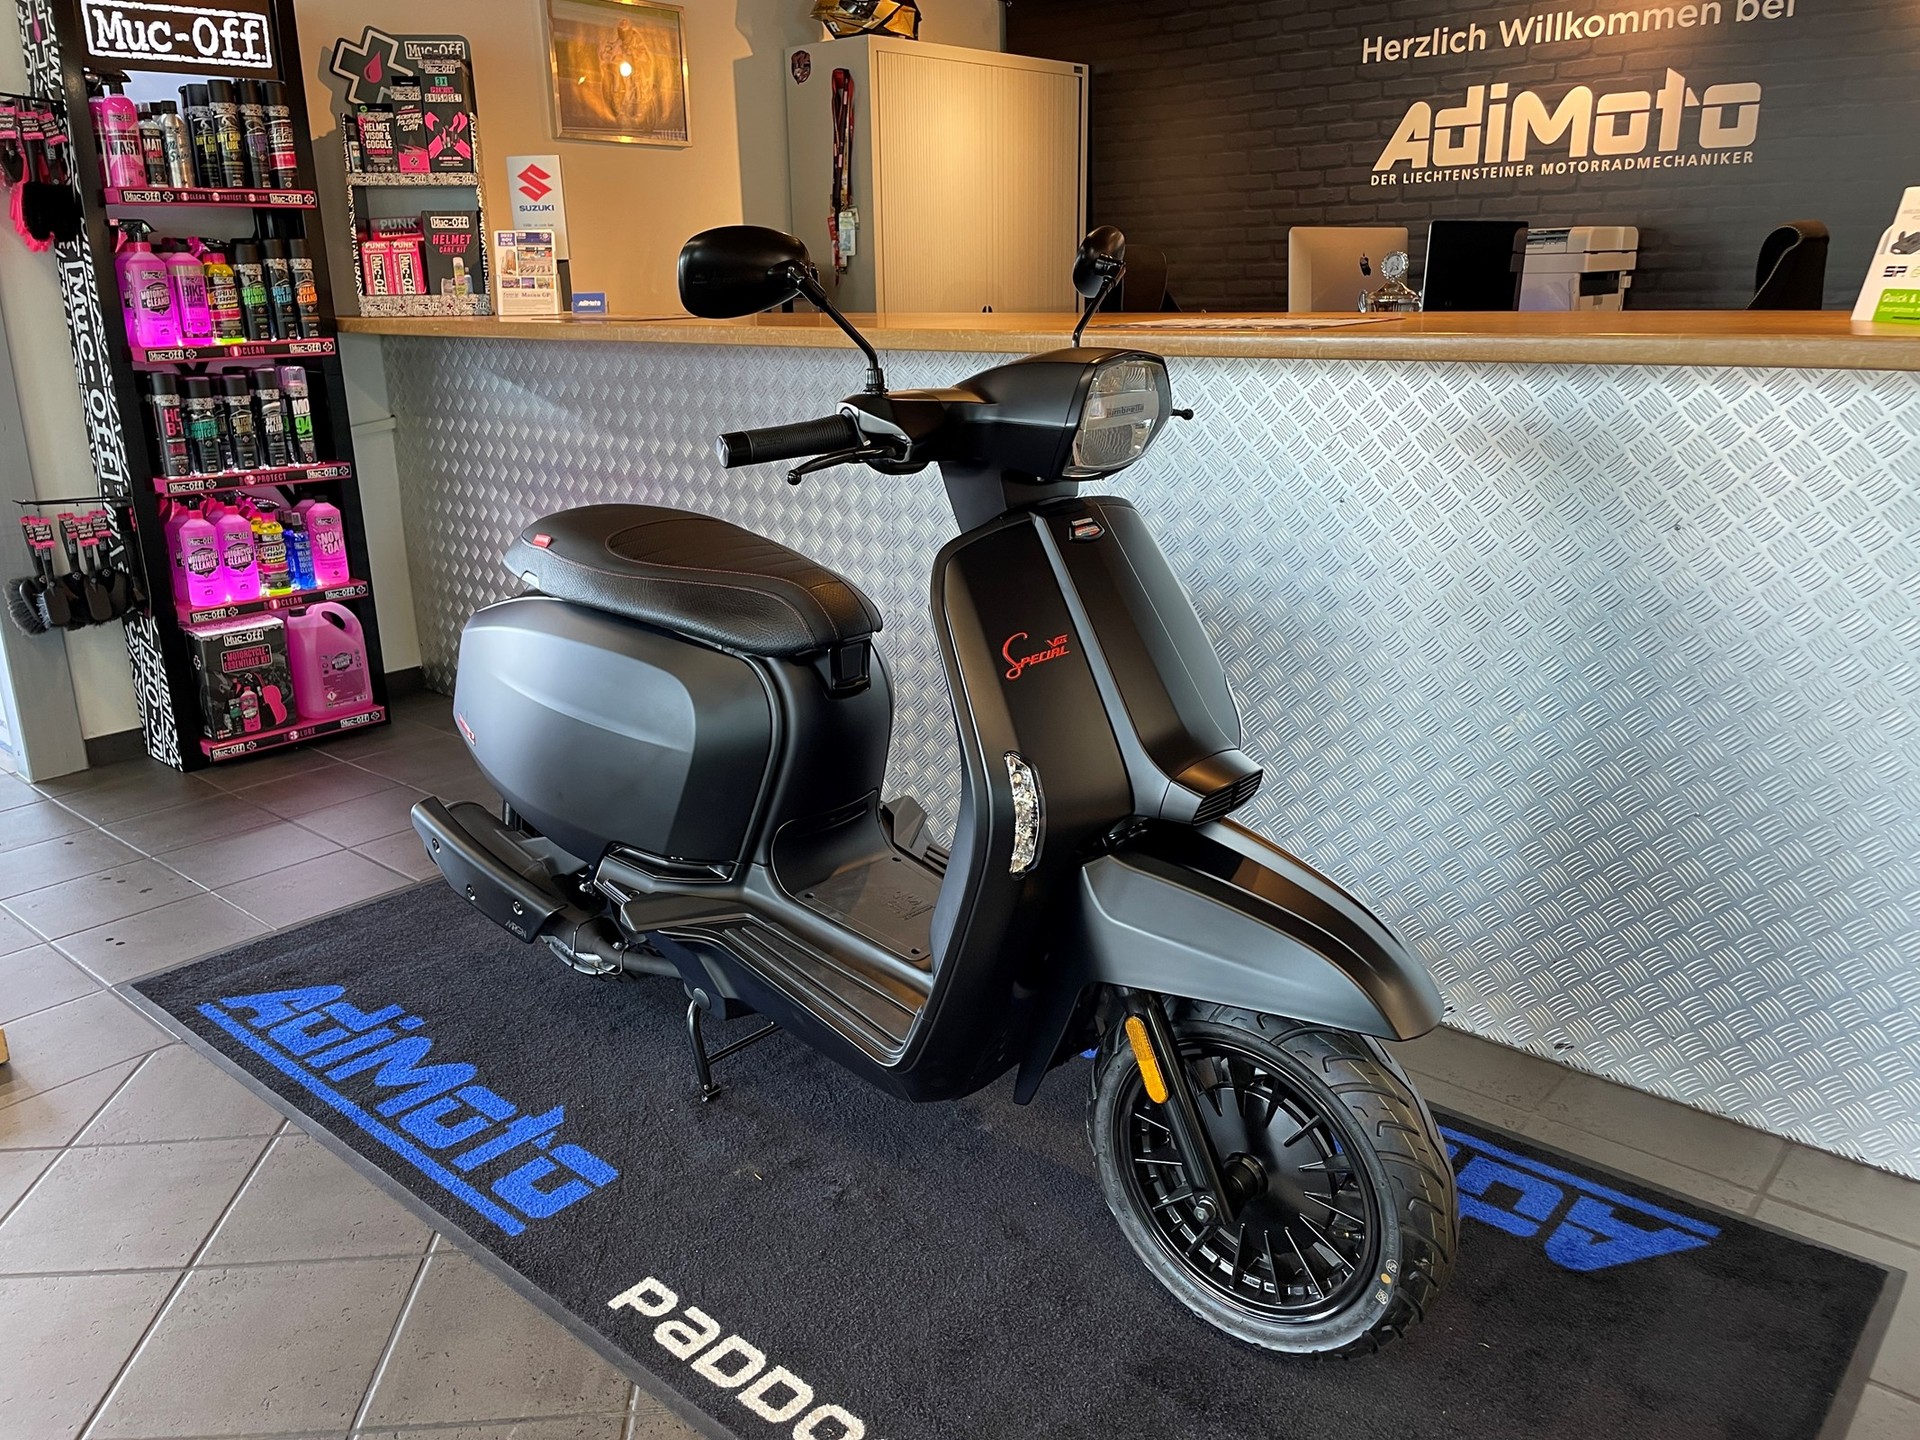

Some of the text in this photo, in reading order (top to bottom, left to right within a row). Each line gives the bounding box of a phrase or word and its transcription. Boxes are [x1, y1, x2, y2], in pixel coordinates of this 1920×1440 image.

[91, 9, 264, 61] Muc-Off
[1362, 23, 1487, 64] Herzlich
[1499, 1, 1722, 48] Willkommen
[408, 43, 463, 58] Muc-Off
[363, 122, 390, 131] HELMET
[1372, 67, 1762, 171] AdiMoto
[365, 131, 392, 140] VISOR &
[109, 141, 141, 156] WASH
[366, 140, 393, 149] GOGGLE
[1370, 151, 1754, 186] DER LIECHTENSTEINER MOTORRADMECHANIKER
[519, 204, 555, 213] SUZUKI
[379, 217, 417, 230] PUNK
[431, 217, 469, 228] Muc-Off
[432, 234, 472, 245] HELMET
[68, 272, 120, 476] Muc-Off
[315, 530, 341, 545] SNOW
[224, 629, 263, 646] Muc-Off
[219, 984, 620, 1220] AdiMoto
